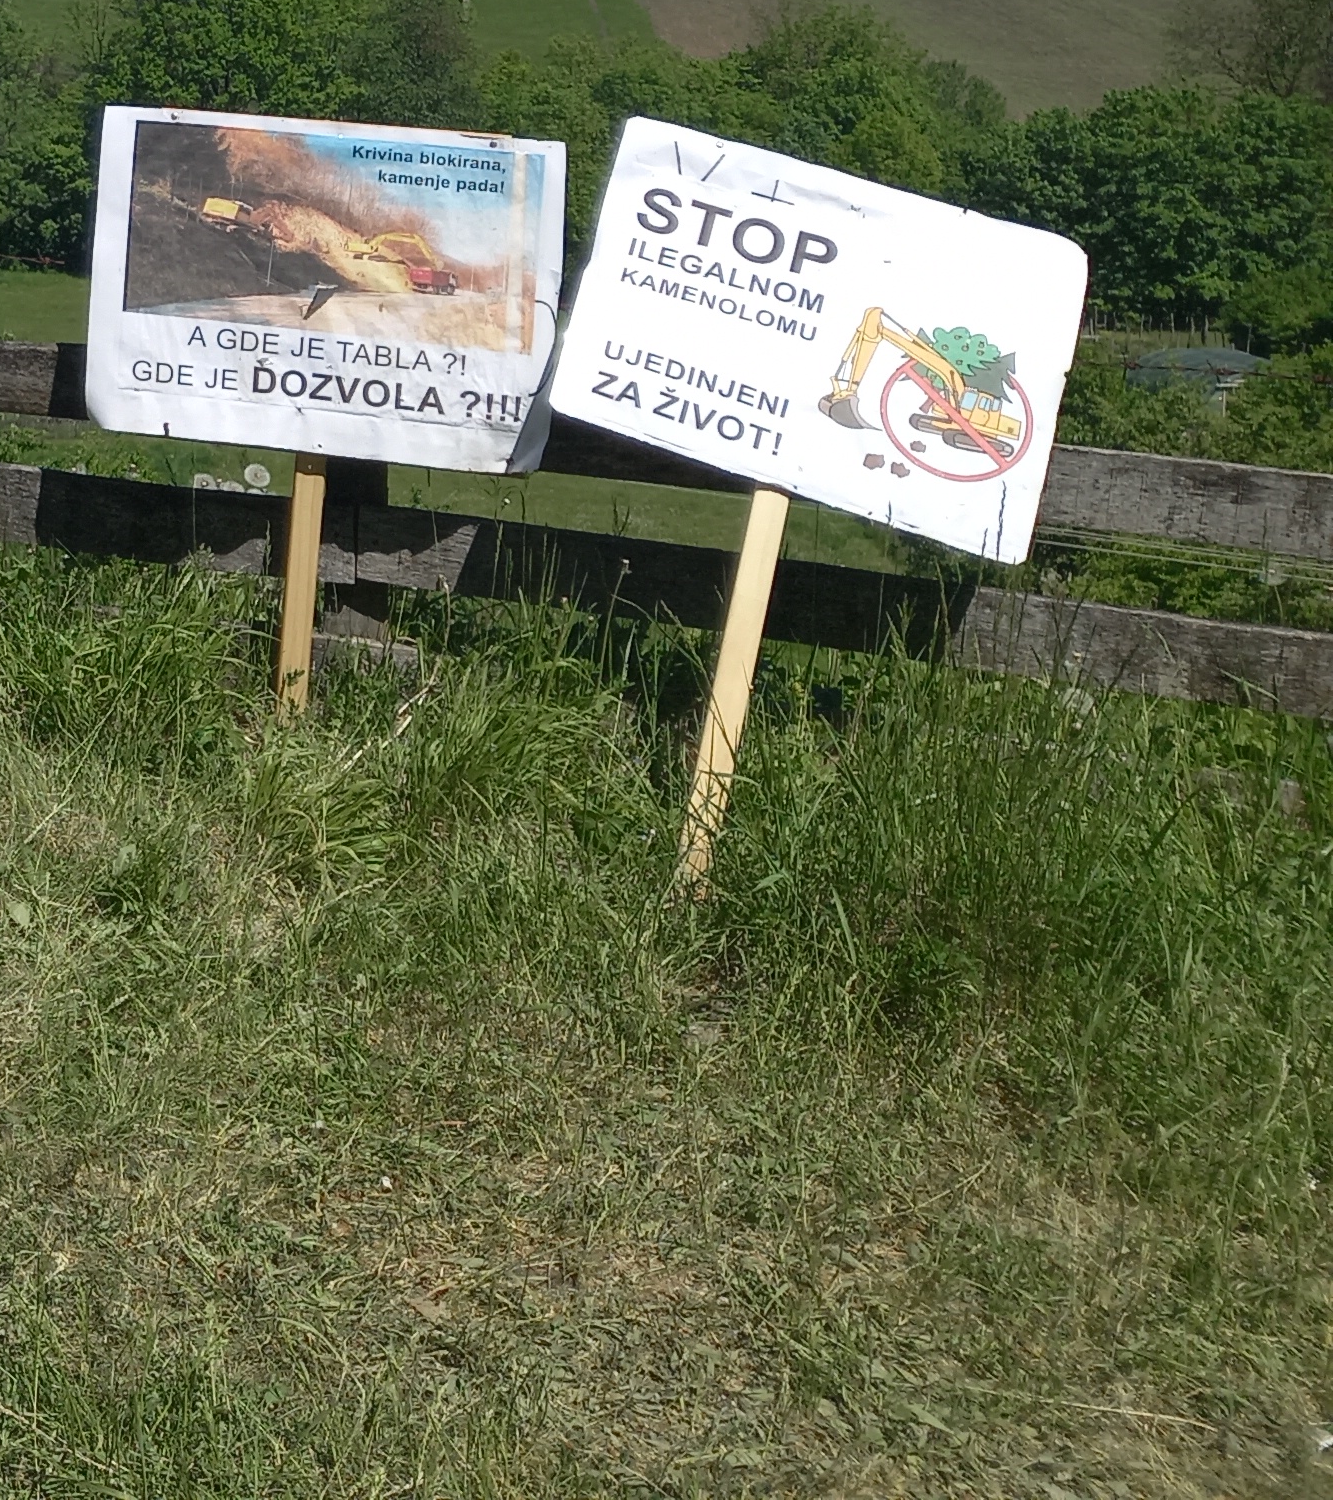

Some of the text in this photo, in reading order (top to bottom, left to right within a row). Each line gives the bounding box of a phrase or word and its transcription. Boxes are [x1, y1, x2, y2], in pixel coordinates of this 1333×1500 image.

[352, 145, 507, 174] Krivina blokirana,
[378, 169, 505, 194] kamenje pada!
[636, 188, 838, 274] STOP
[620, 267, 817, 341] KAMENOLOMU
[628, 238, 825, 314] ILEGALNOM
[187, 325, 206, 347] A
[216, 329, 280, 355] GDE
[290, 336, 325, 360] JE
[336, 340, 432, 373] TABLA
[604, 340, 790, 418] UJEDINJENI
[132, 360, 194, 386] GDE
[204, 368, 239, 391] JE
[251, 366, 445, 416] DOZVOLA
[591, 370, 783, 456] ZA ŽIVOT!
